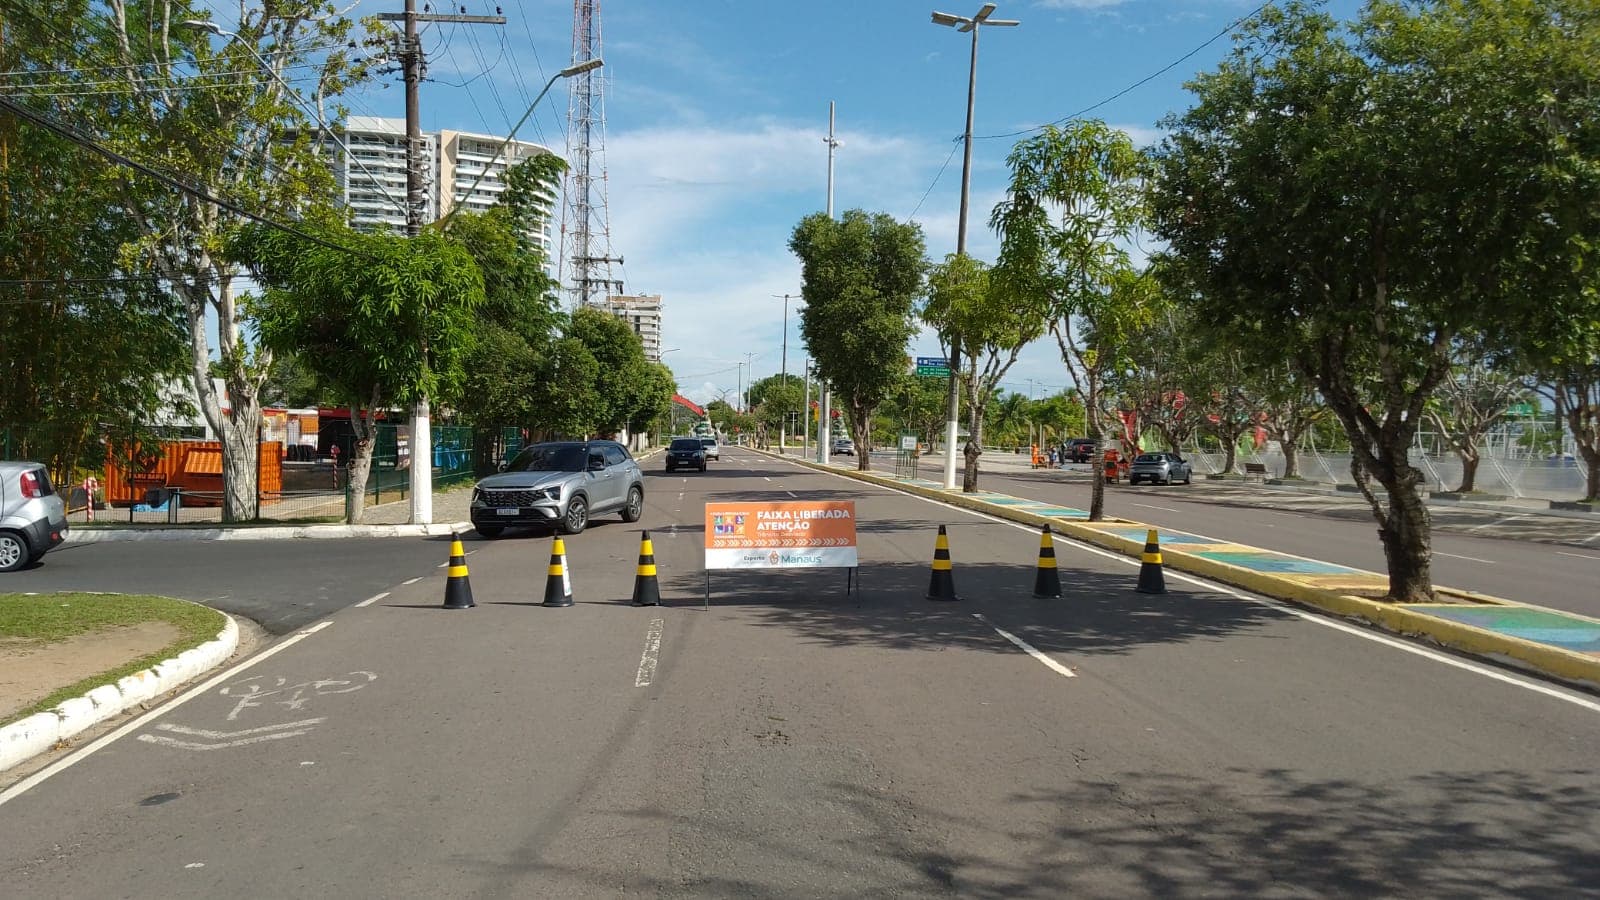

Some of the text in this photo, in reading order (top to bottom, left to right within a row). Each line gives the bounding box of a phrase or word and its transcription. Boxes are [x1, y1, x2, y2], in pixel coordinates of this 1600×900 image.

[757, 511, 791, 519] FAIXA
[794, 510, 850, 519] LIBERADA
[757, 518, 809, 531] ATENÇÃO
[781, 554, 822, 563] Manaus
